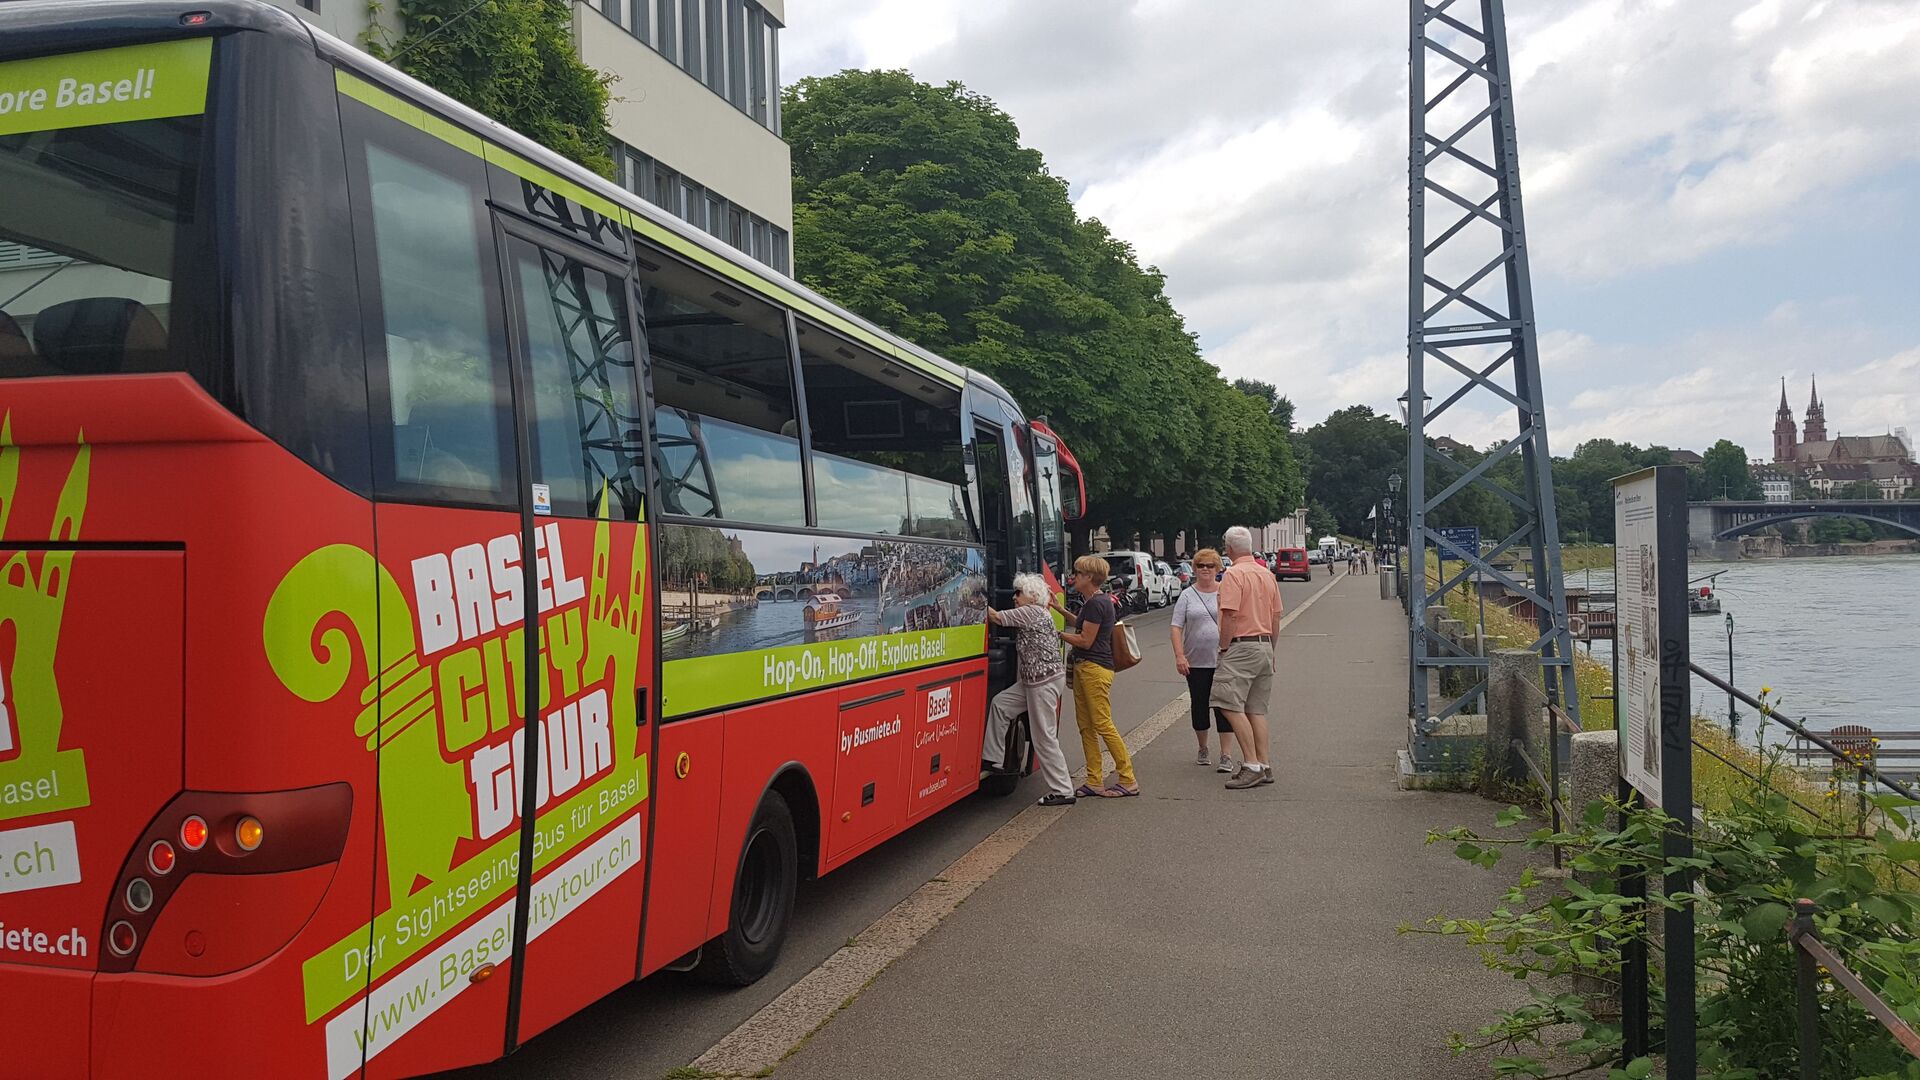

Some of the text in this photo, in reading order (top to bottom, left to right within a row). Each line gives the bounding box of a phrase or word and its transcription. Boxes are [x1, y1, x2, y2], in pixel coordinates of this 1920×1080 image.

[56, 69, 154, 108] Basel!
[411, 522, 586, 656] BASEL
[763, 632, 946, 693] Hop-On, Hop-Off, Explore Basel!
[928, 689, 951, 718] Basel
[841, 713, 901, 756] by Busmiete.ch
[0, 769, 59, 805] asel
[343, 769, 639, 982] Der Sightseeing Bus für Basel
[353, 835, 632, 1051] www.Baselitytour.ch
